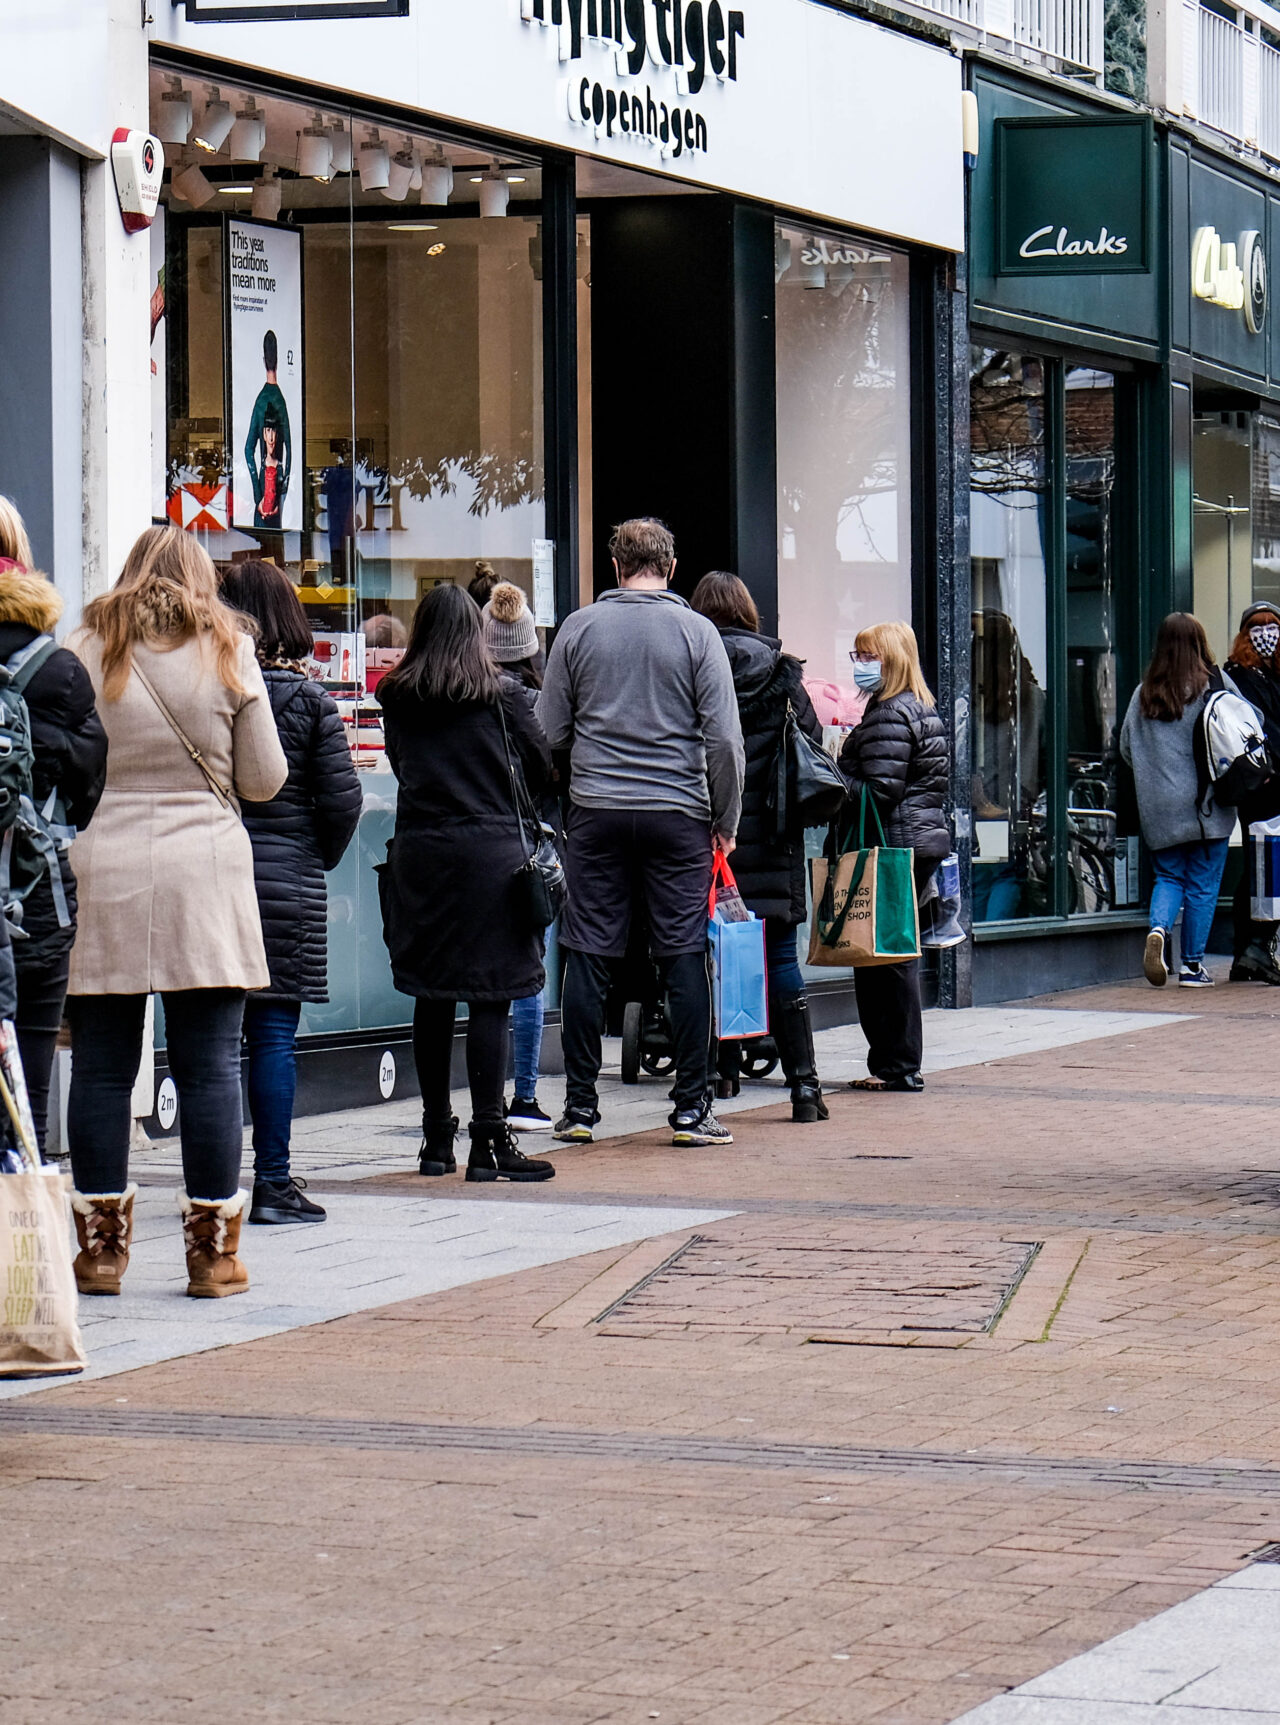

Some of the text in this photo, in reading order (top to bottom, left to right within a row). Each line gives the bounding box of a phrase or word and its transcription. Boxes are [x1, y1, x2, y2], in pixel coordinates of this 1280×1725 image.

[651, 0, 745, 94] tiger
[579, 77, 708, 158] copenhagen
[231, 230, 265, 257] This year
[1019, 225, 1129, 258] Clarks
[231, 252, 269, 272] traditions
[232, 273, 276, 292] mean more
[287, 350, 294, 365] £2
[841, 887, 870, 898] THGS
[850, 900, 870, 909] VERY
[847, 911, 871, 921] SHOP
[382, 1066, 393, 1081] 2m
[161, 1094, 174, 1110] 2m
[7, 1265, 34, 1295] LOVE
